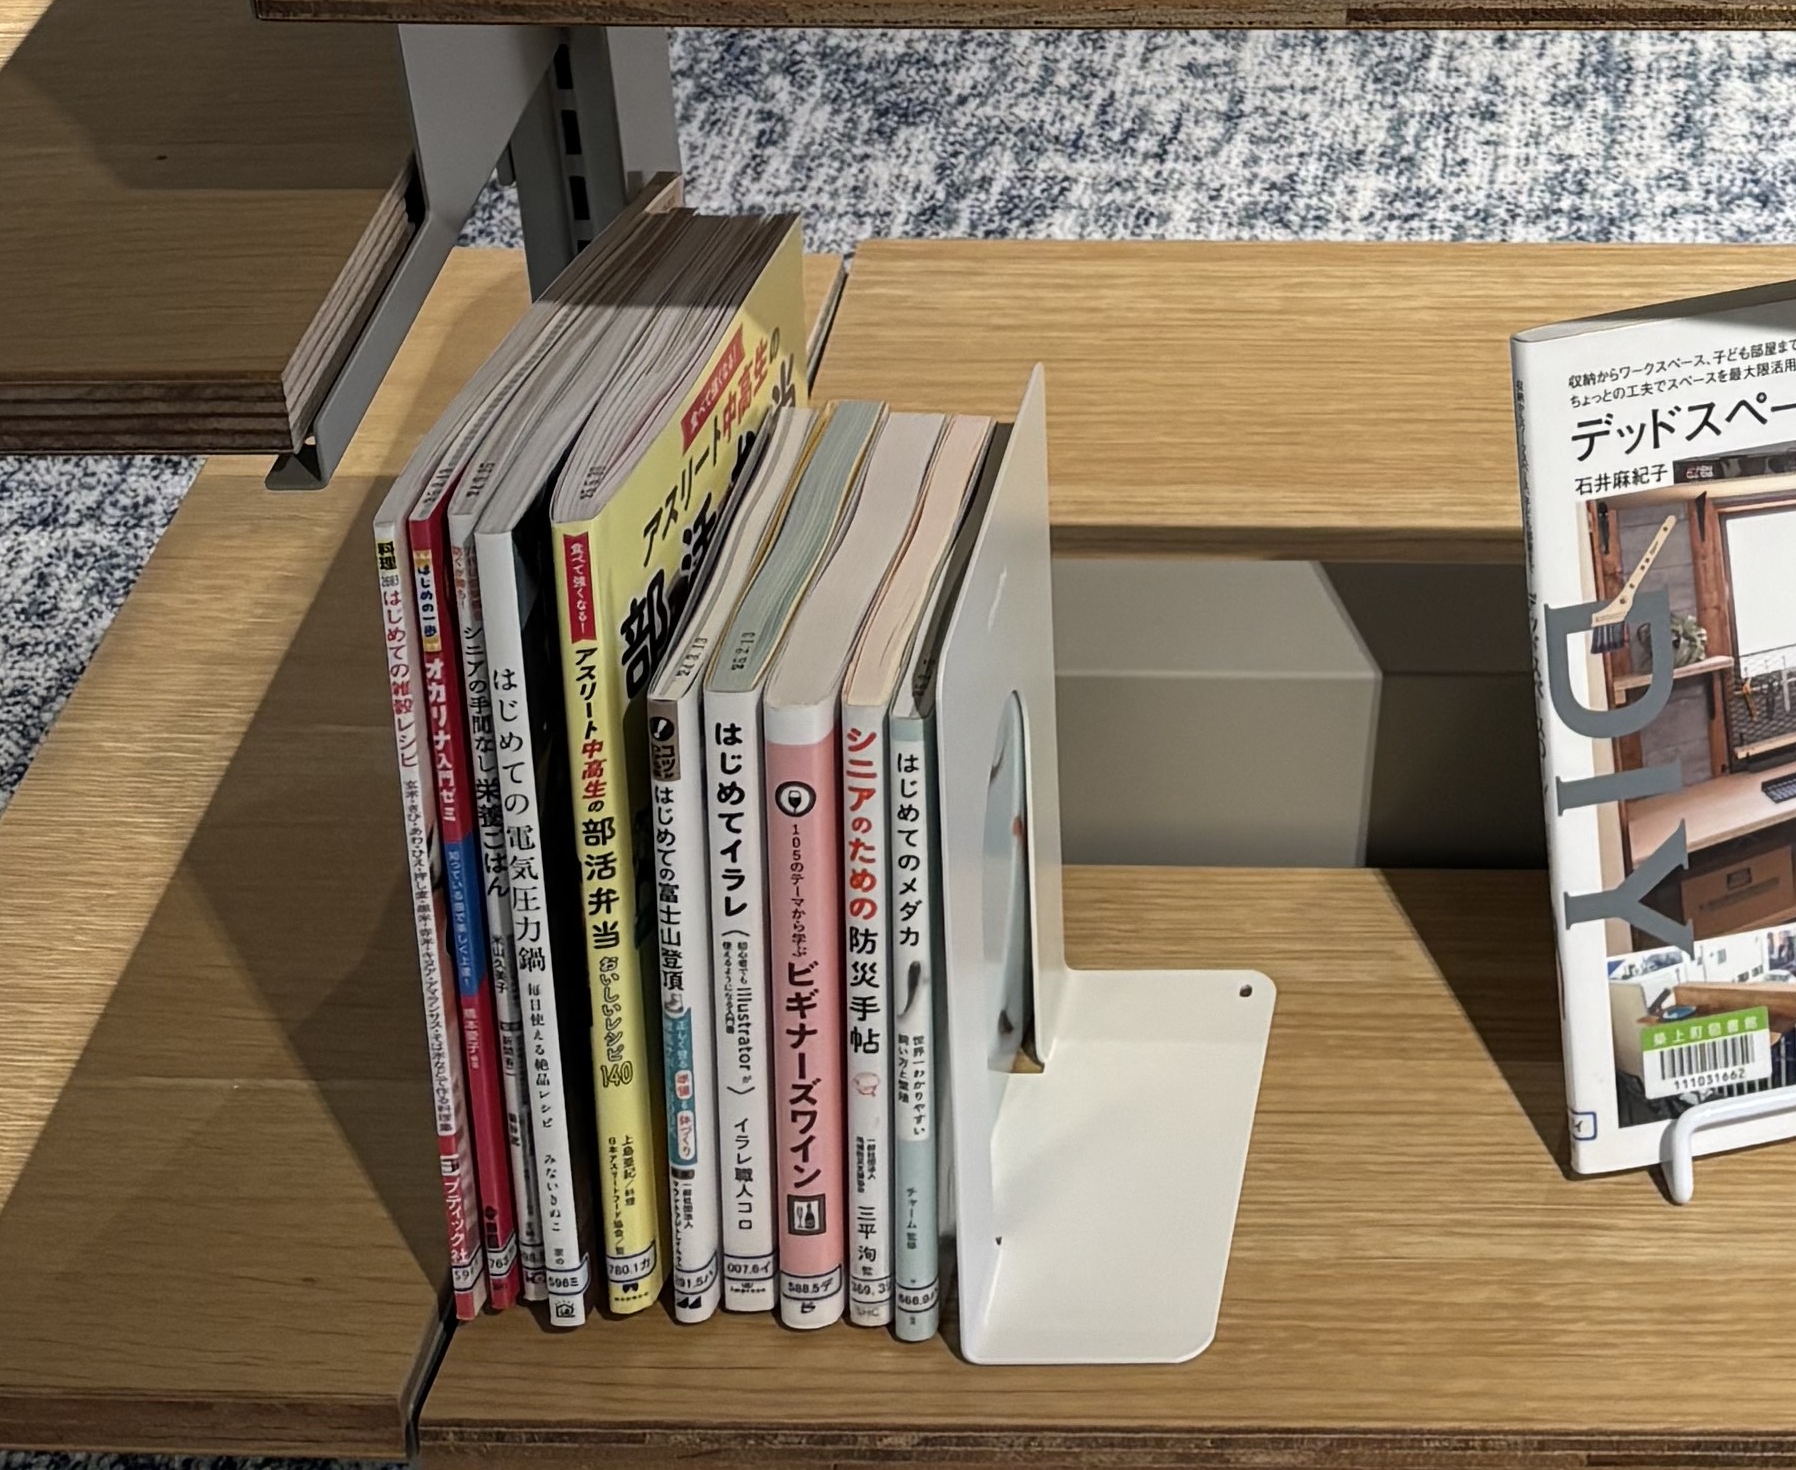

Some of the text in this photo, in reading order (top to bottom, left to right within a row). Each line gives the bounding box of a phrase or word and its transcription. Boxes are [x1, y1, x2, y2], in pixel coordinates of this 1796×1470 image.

[1574, 463, 1669, 496] 石井麻紀子
[417, 564, 437, 637] はじめの一歩
[569, 542, 587, 634] 食べて強くなる！
[382, 590, 418, 768] はじめての雑穀レシピ
[425, 658, 456, 822] オカリナ入門ゼミ
[463, 626, 510, 897] シニアの手間なし栄養ごはん
[493, 668, 546, 972] はじめての電気圧力鍋
[575, 647, 620, 950] アスリート中高生の部活弁当
[715, 722, 748, 917] はじめてイラレ
[897, 752, 922, 947] はじめてのメダカ
[1544, 587, 1695, 957] DIY
[655, 785, 684, 992] はじめての富士山登頂
[790, 824, 808, 958] 105のテーマから学ぶ
[846, 727, 881, 1055] シニアのための防災手帖
[528, 983, 553, 1128] 毎日使える絶品レシピ
[784, 960, 821, 1189] ビギナーズワイン
[912, 1035, 927, 1136] 世界一わかりやすい
[1674, 1068, 1746, 1090] 111031662
[734, 1117, 754, 1230] イラレ職人コロ
